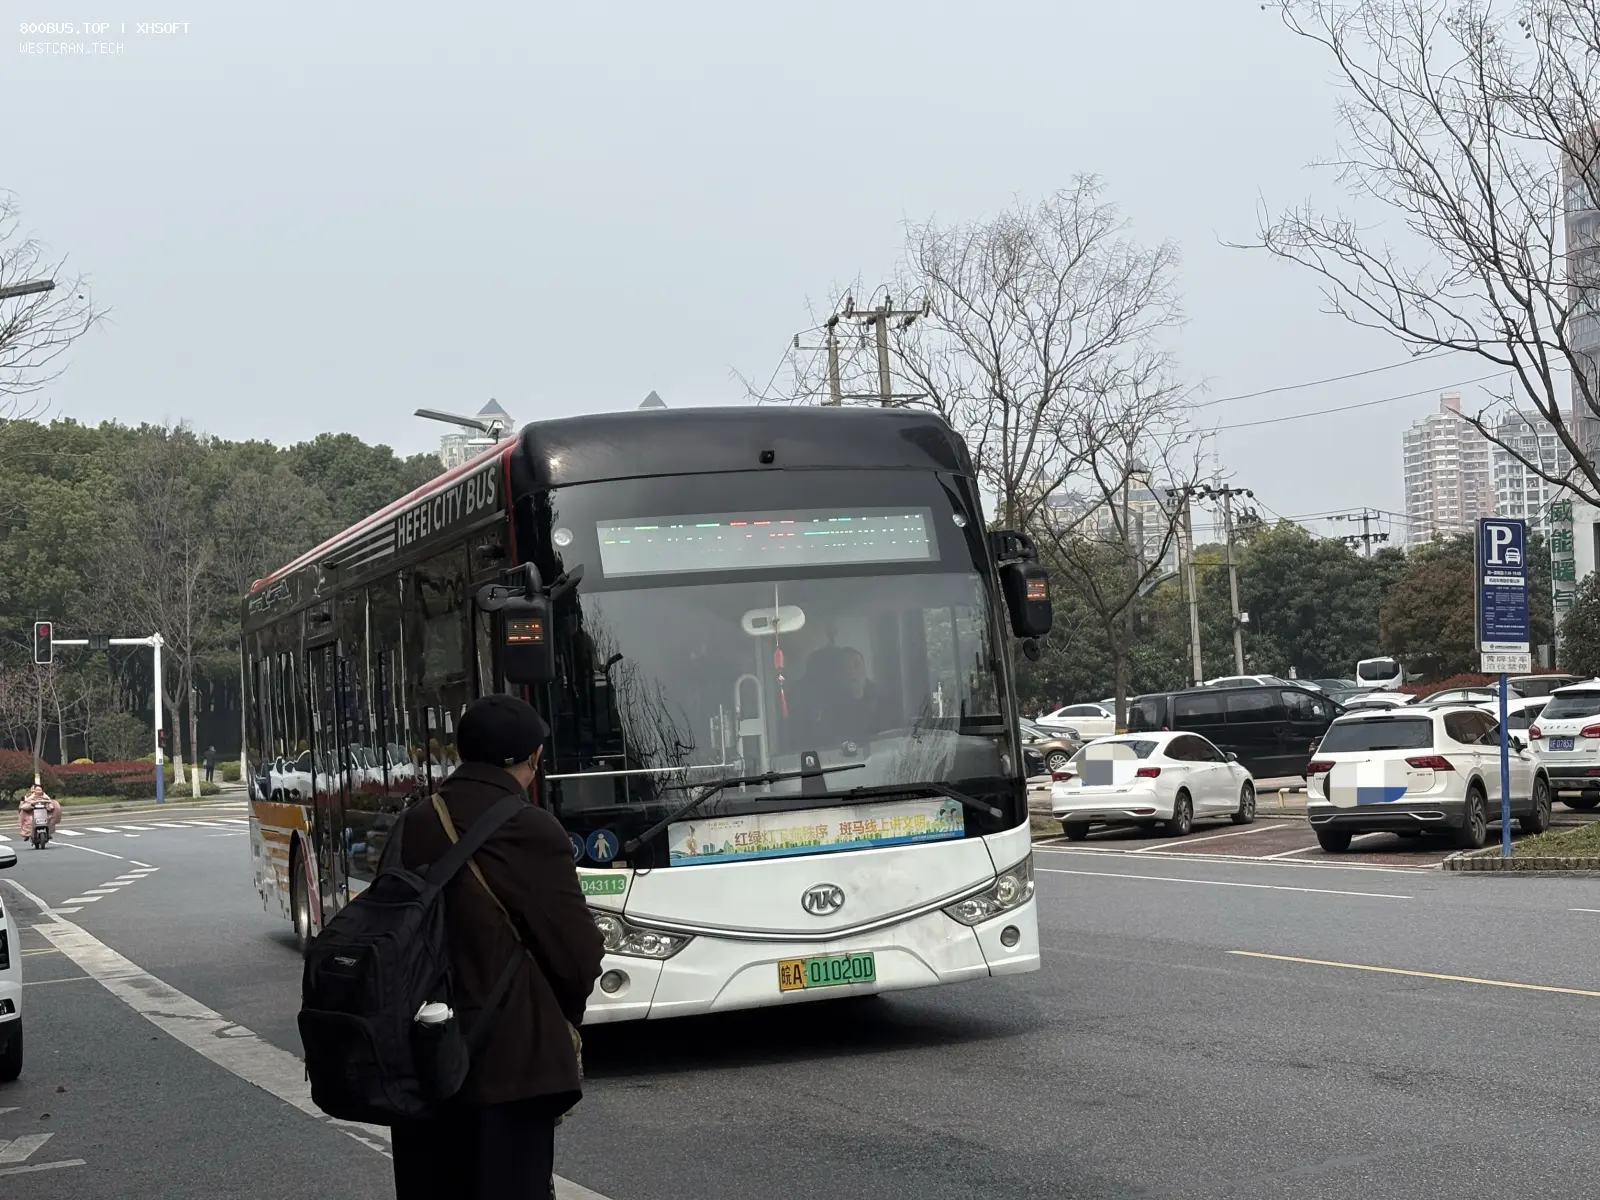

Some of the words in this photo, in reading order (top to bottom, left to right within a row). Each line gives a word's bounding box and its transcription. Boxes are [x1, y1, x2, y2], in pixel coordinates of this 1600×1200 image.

[397, 502, 431, 549] HEFEI
[433, 483, 464, 531] CITY
[466, 466, 496, 515] BUS
[1486, 525, 1513, 565] P
[839, 813, 926, 836] 斑马线上讲文明
[581, 879, 625, 891] D43113
